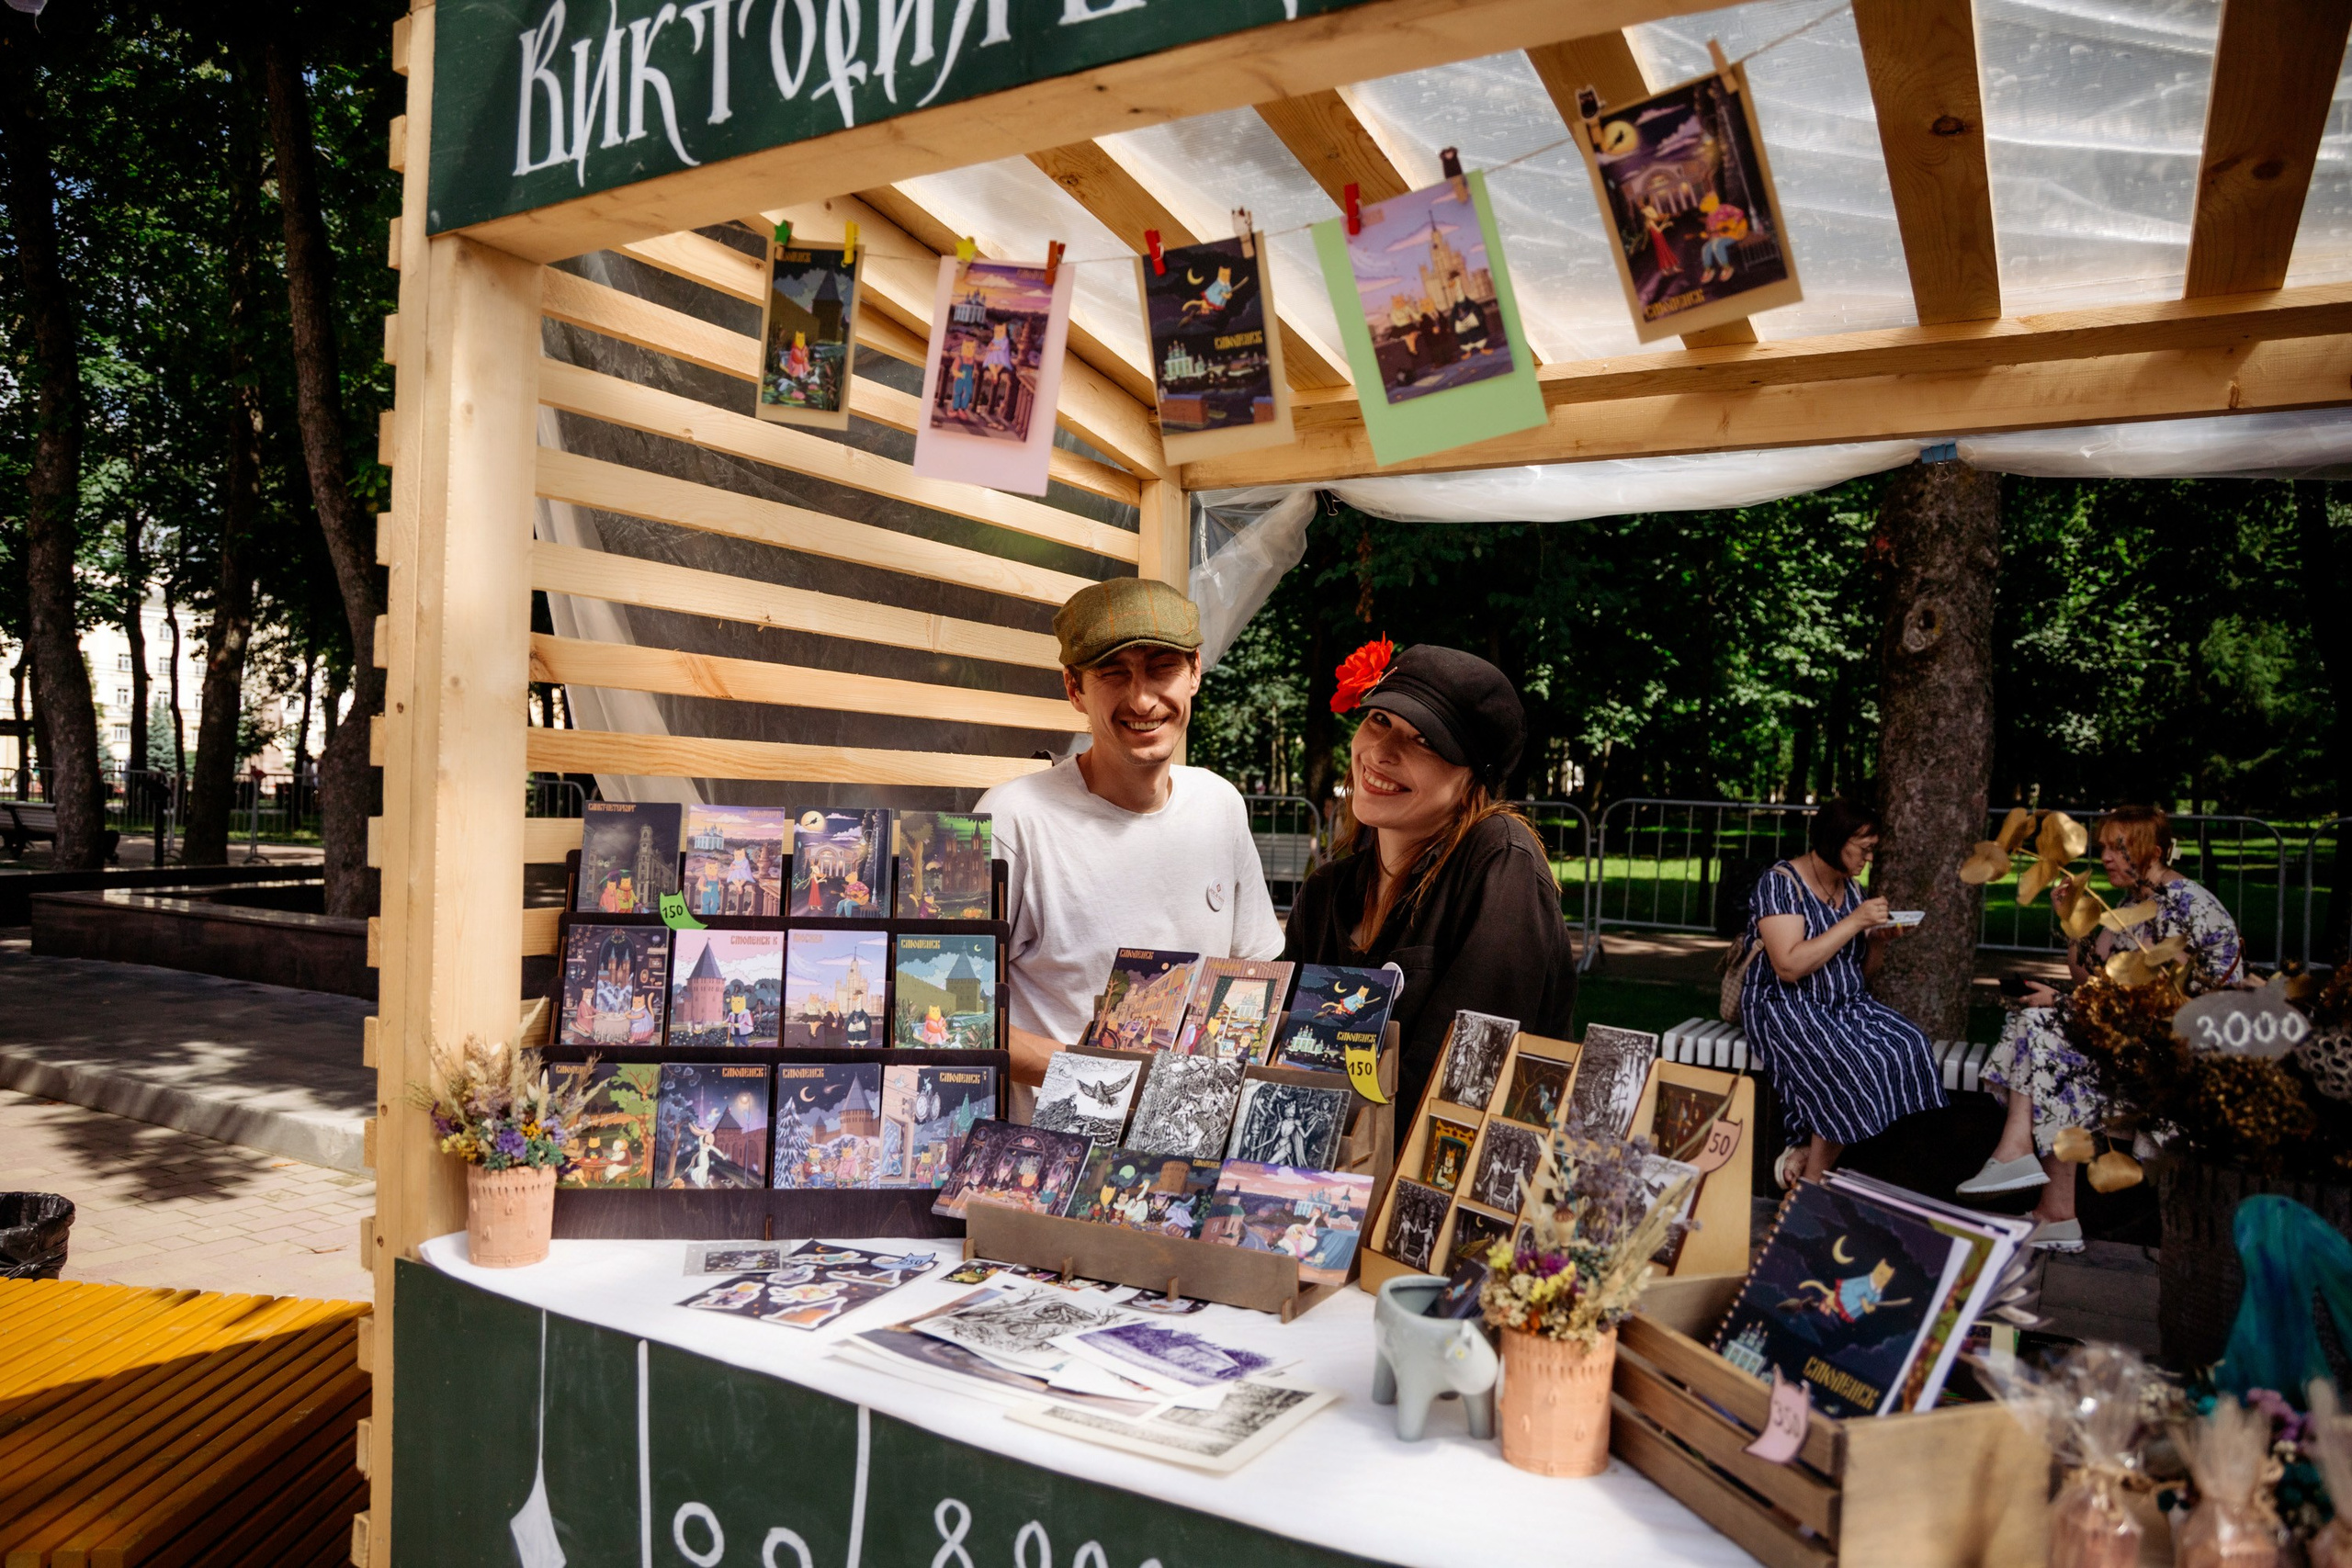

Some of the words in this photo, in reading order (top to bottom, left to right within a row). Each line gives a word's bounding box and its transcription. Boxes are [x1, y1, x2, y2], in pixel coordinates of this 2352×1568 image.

[1214, 330, 1263, 350] СМОЛЕНСК
[662, 905, 684, 919] 150
[730, 935, 771, 945] СМОЛЕНСК
[900, 939, 941, 950] СМОЛЕНСК
[1118, 949, 1155, 960] СМОЛЕНСК
[1336, 1031, 1376, 1043] СМОЛЕНСК
[722, 1066, 763, 1077] СМОЛЕНСК
[782, 1067, 824, 1078] СМОЛЕНСК
[1348, 1061, 1374, 1077] 150
[939, 1072, 980, 1084] СМОЛЕНСК
[1708, 1132, 1731, 1156] 50
[1803, 1356, 1881, 1411] СМОЛЕНСК
